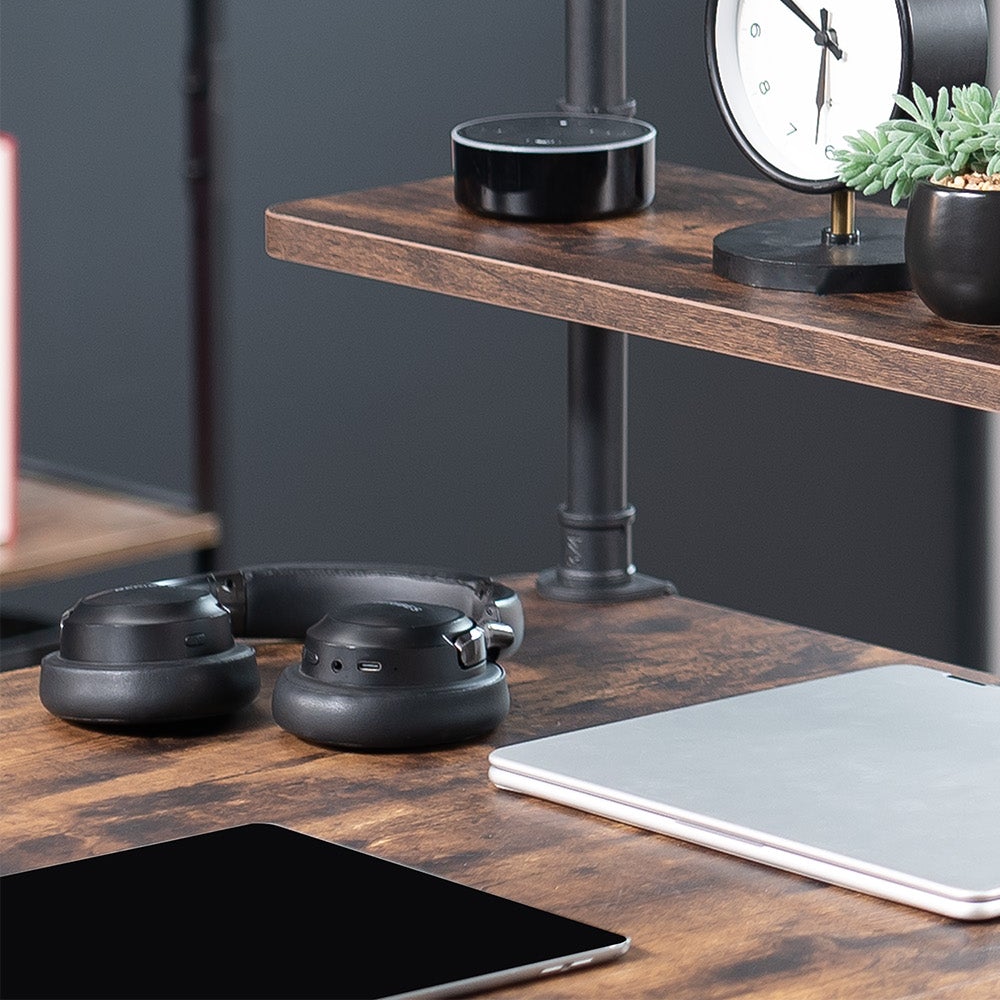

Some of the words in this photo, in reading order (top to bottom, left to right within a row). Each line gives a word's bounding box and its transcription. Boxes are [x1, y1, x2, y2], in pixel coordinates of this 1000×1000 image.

[750, 22, 762, 38] 9
[758, 80, 771, 96] 8
[786, 122, 798, 136] 7
